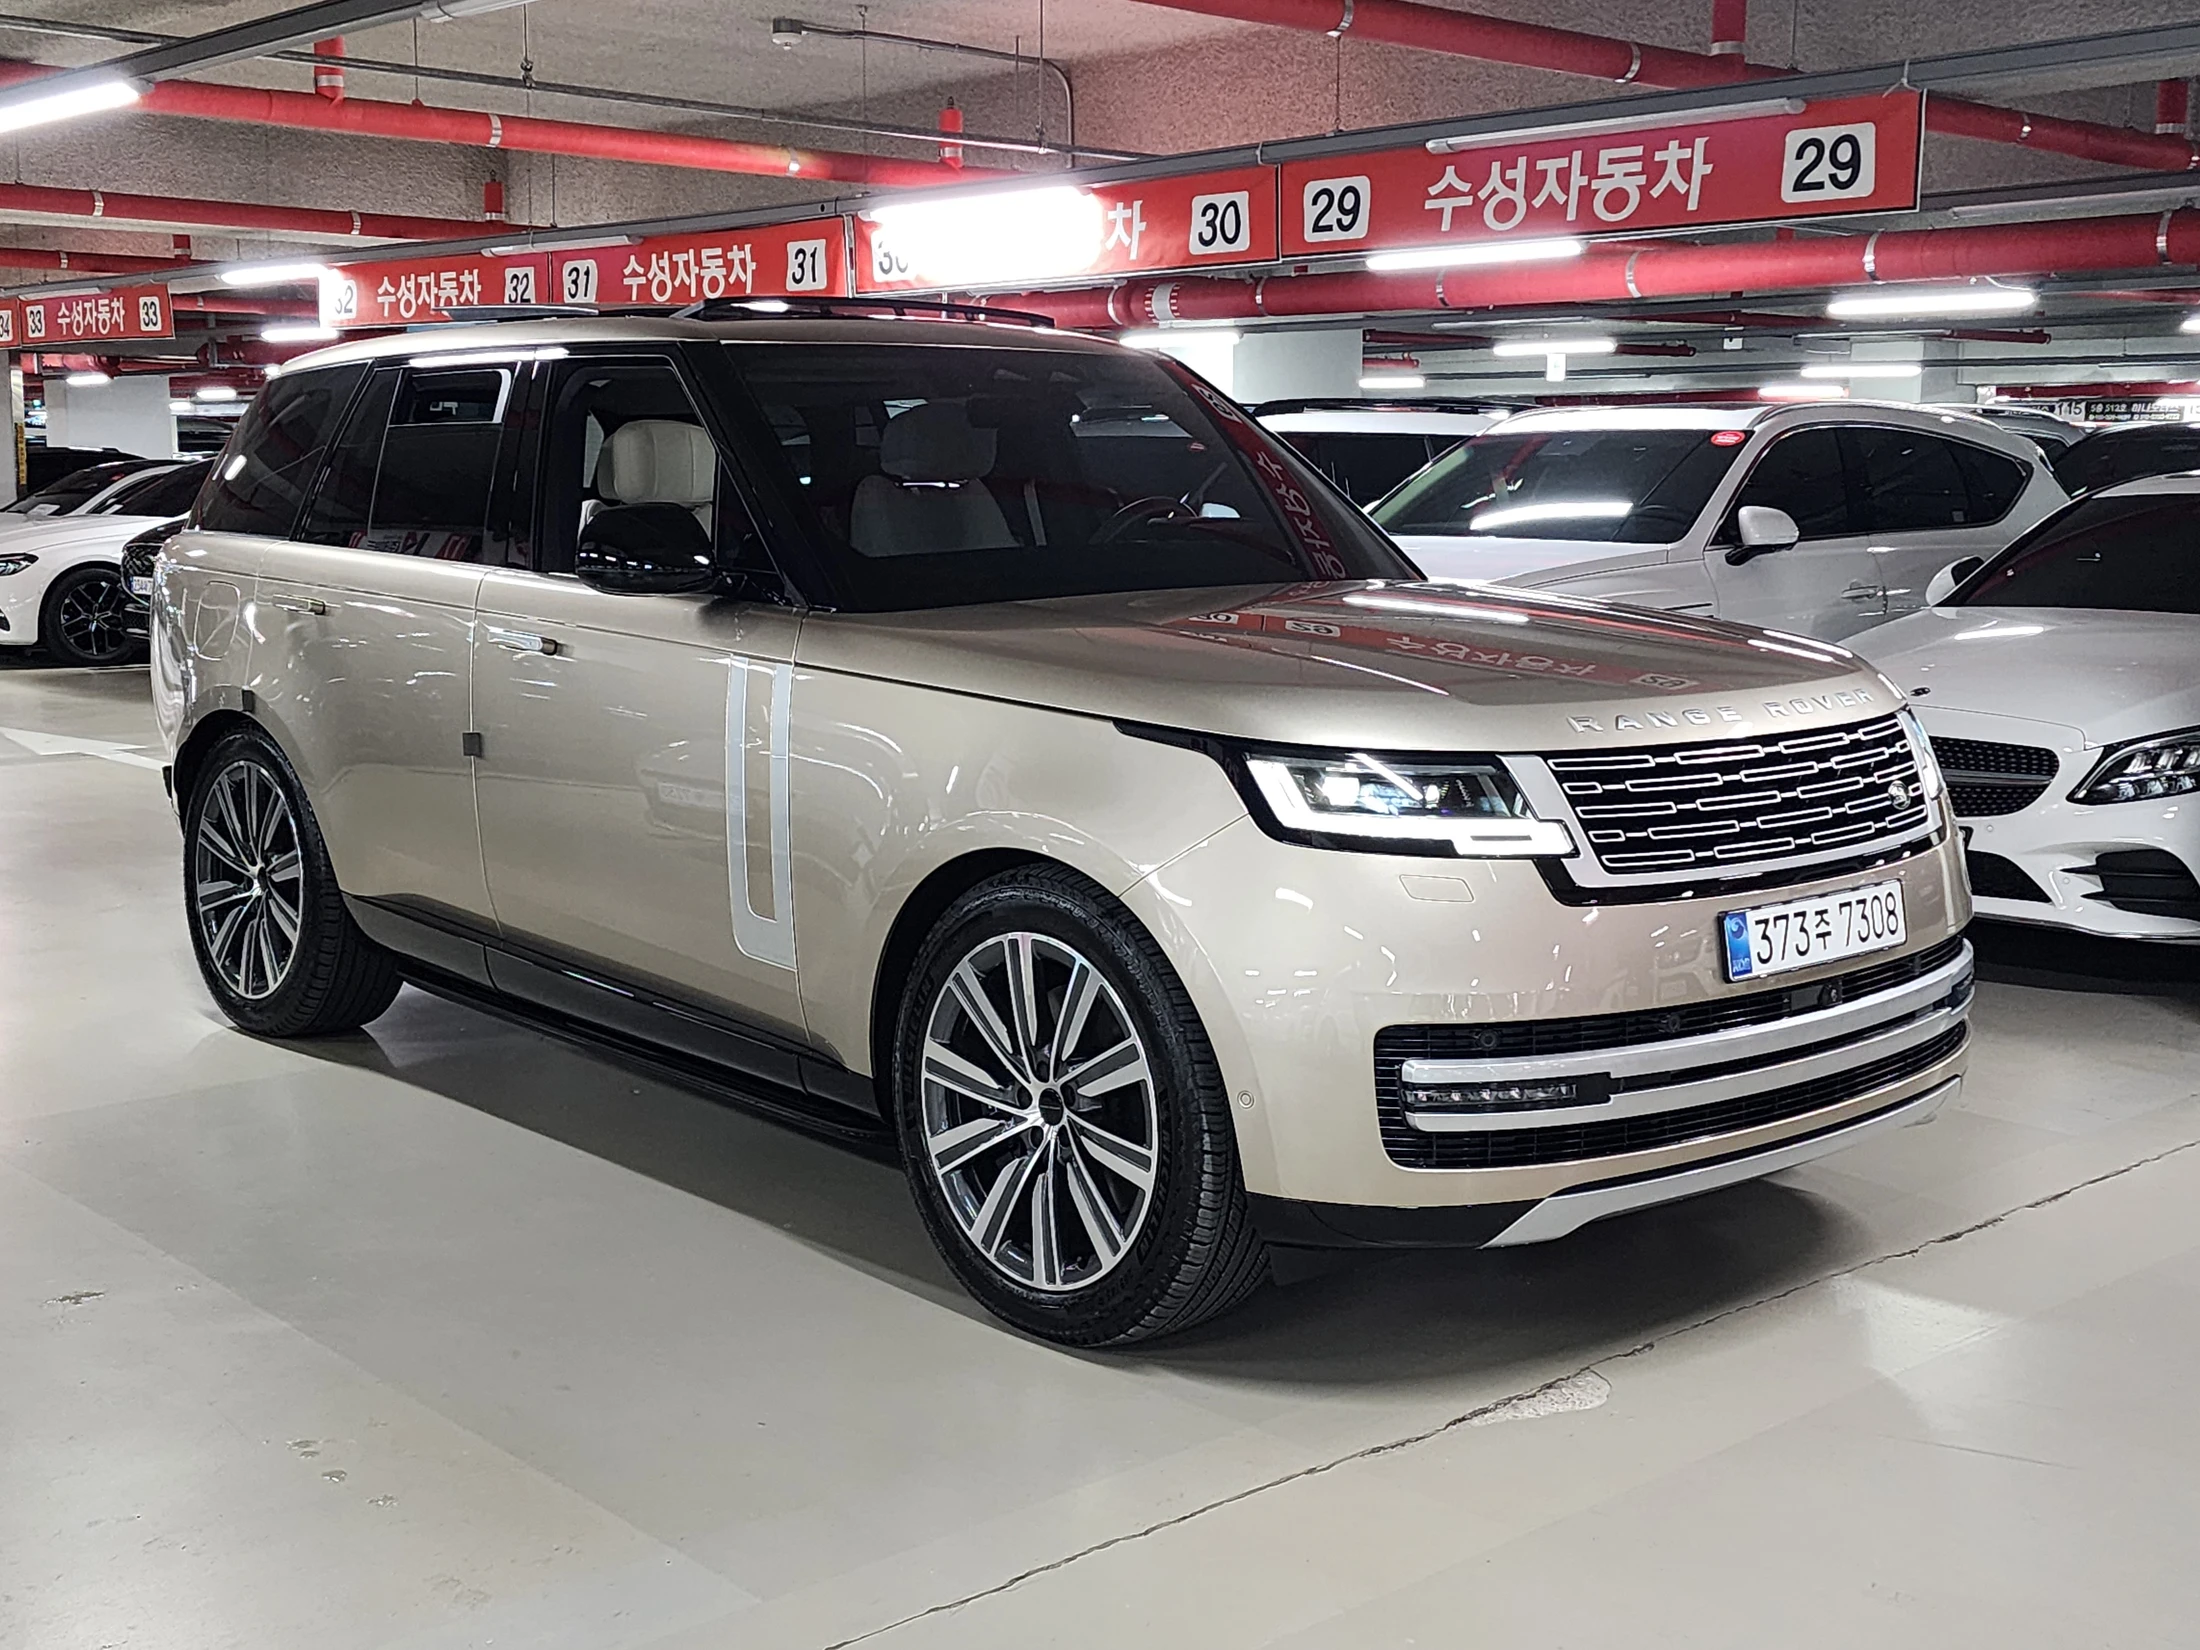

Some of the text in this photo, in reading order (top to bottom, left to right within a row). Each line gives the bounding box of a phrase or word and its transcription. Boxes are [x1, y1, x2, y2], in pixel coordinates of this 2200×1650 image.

[1310, 133, 1862, 234] 29 수성자동차 29
[1197, 202, 1243, 246] 30
[377, 268, 482, 319] 수성자동차
[508, 273, 531, 303] 32
[567, 244, 821, 304] 31 수성자동차 31
[29, 297, 158, 337] 33 수성자동차 33
[1567, 688, 1874, 734] RANGE ROVER
[1754, 891, 1899, 965] 373주 7308
